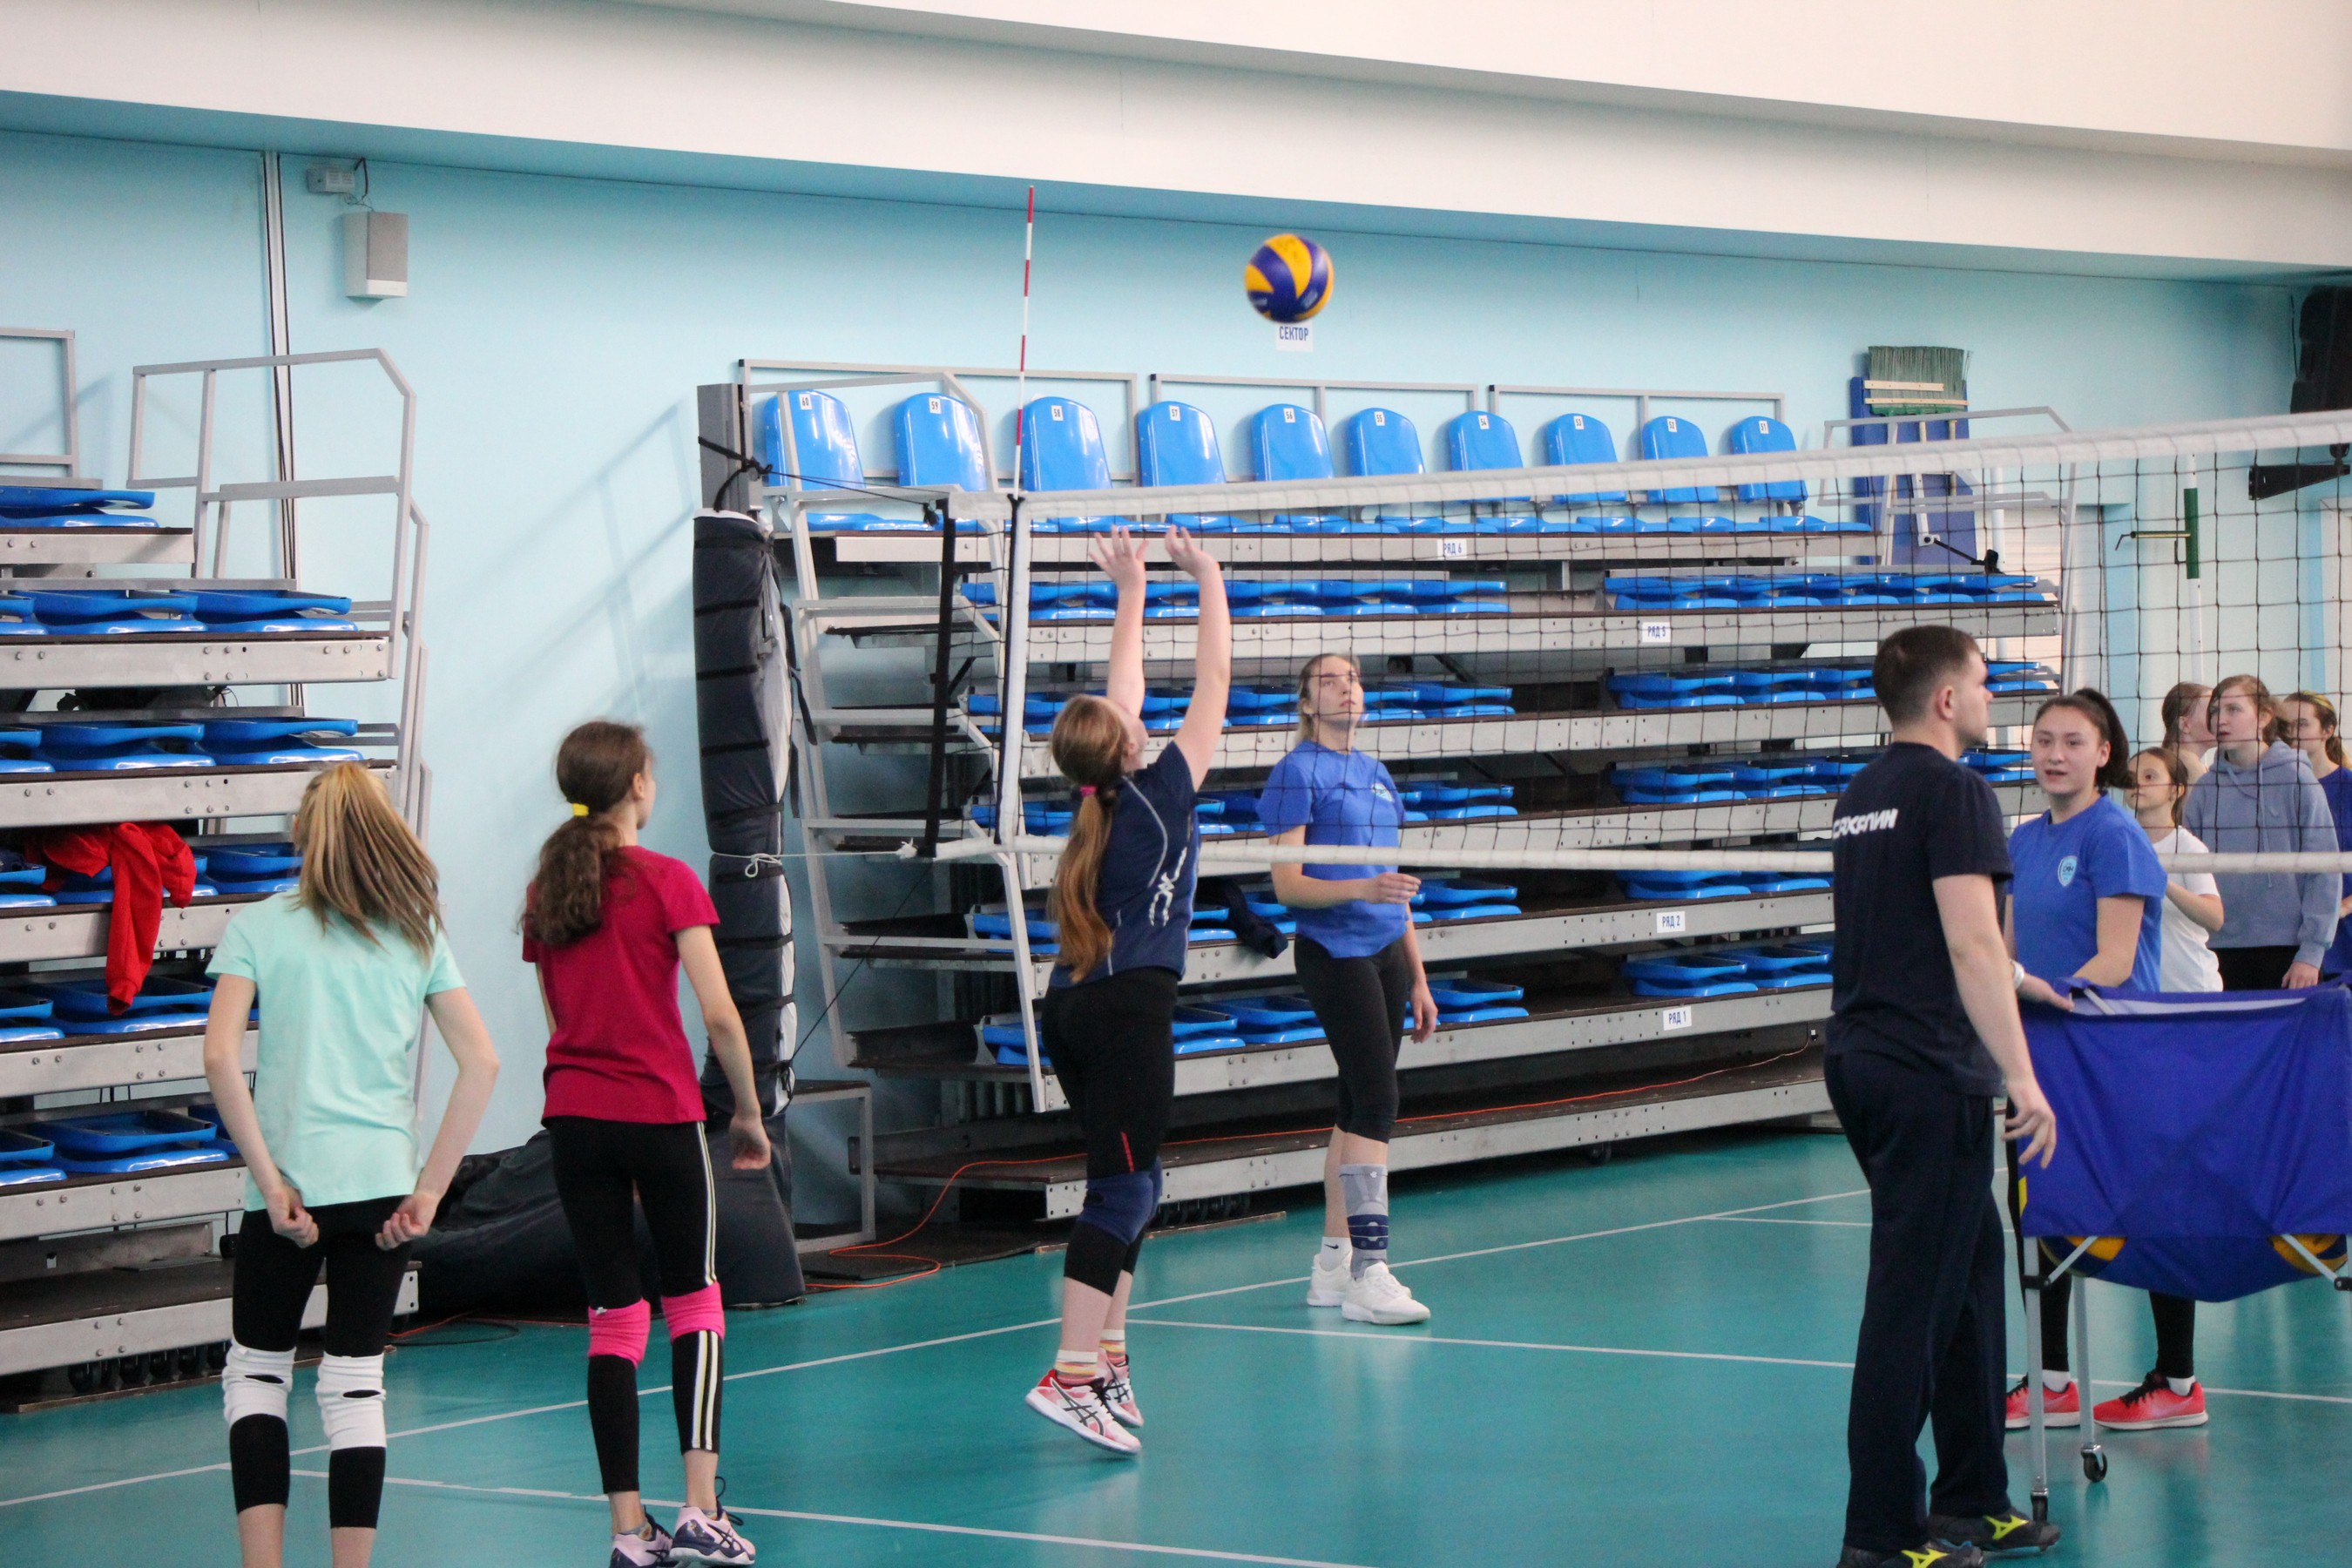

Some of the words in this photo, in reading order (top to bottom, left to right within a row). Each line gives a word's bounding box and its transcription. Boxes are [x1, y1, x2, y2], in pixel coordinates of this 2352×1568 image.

[1279, 326, 1309, 341] СЕКТОР
[801, 397, 809, 407] 60
[931, 401, 938, 410] 59
[1053, 409, 1061, 417] 58
[1172, 409, 1178, 417] 57
[1286, 411, 1293, 420] 56
[1480, 417, 1487, 426] 54
[1761, 422, 1767, 431] 51
[1443, 543, 1456, 555] РЯД
[1458, 543, 1463, 553] 6
[1647, 625, 1660, 639] РЯД
[1662, 625, 1666, 637] 5
[1662, 916, 1675, 929] РЯД
[1677, 915, 1680, 926] 2
[1669, 1011, 1681, 1024] РЯД
[1683, 1010, 1686, 1022] 1
